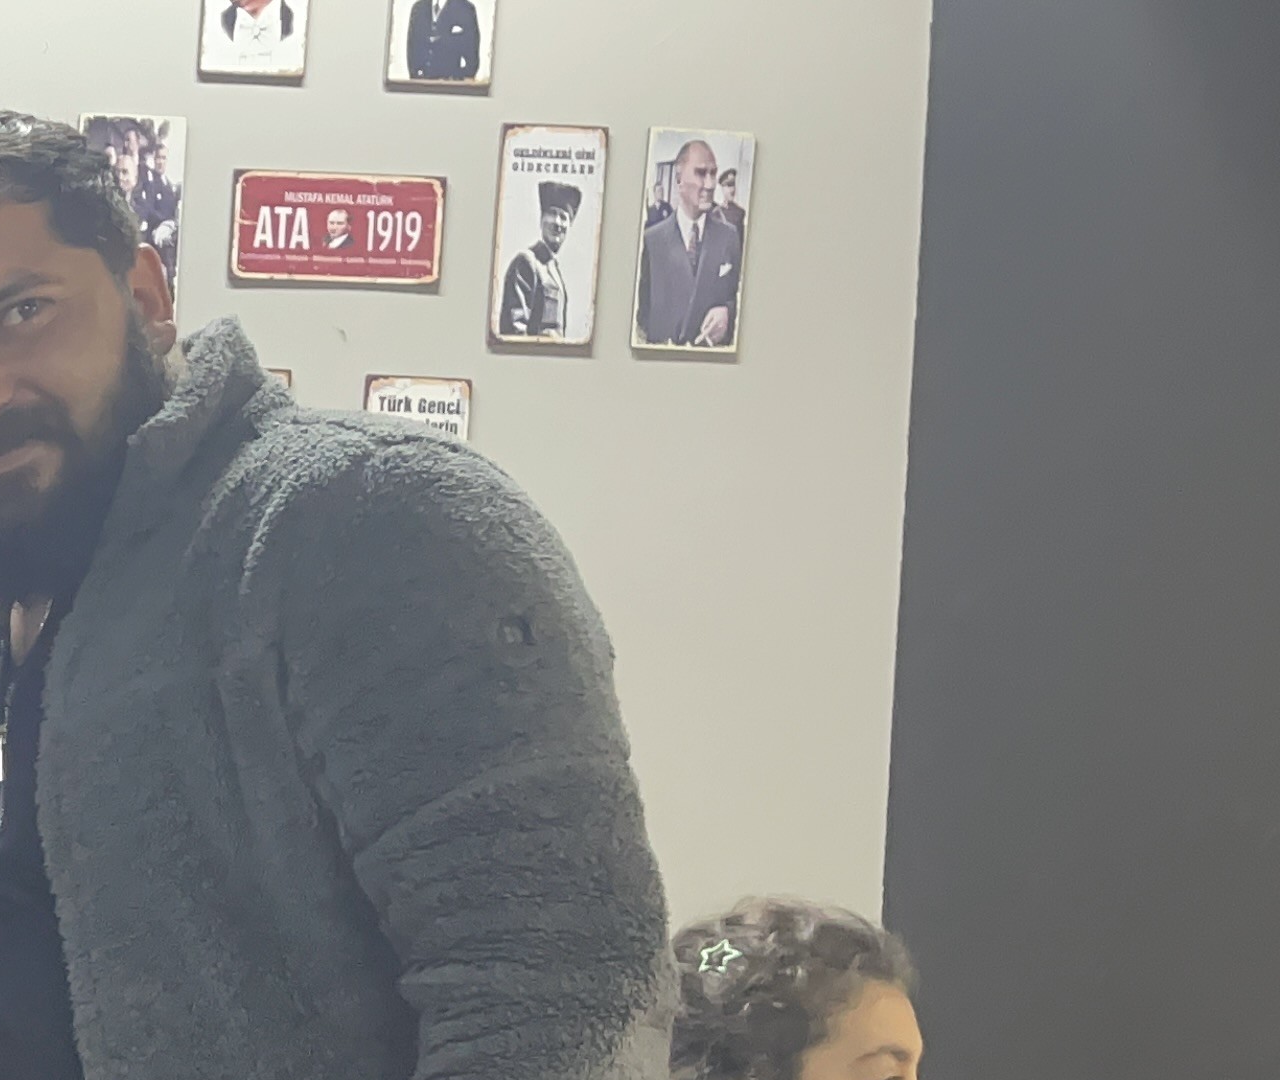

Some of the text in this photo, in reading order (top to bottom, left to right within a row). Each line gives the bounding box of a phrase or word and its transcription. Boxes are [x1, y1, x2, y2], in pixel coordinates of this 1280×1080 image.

[284, 191, 324, 204] MUSTAFA
[325, 193, 354, 205] KEMAL
[253, 205, 422, 253] ATA 1919
[378, 395, 412, 413] Türk
